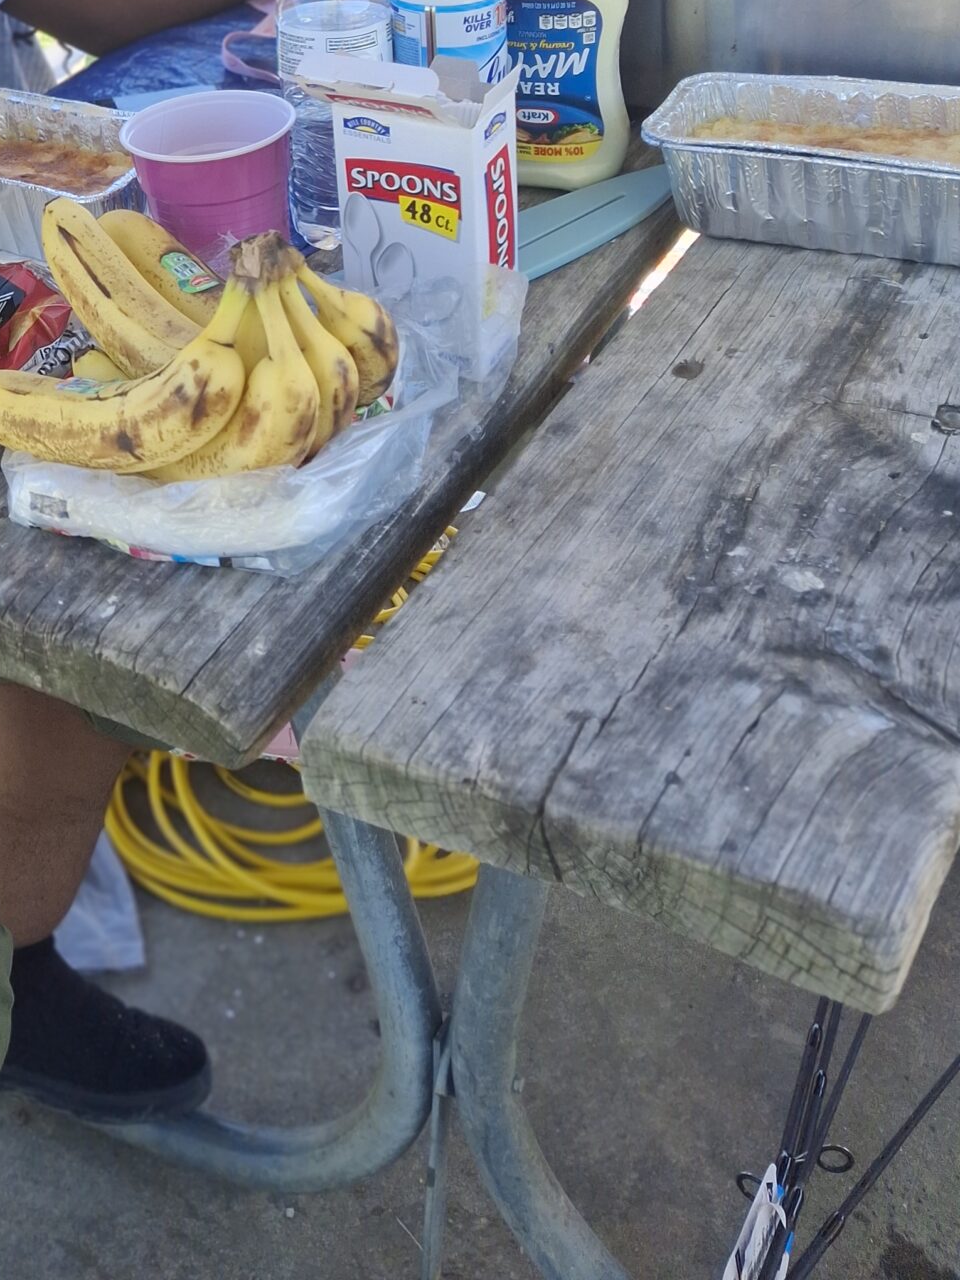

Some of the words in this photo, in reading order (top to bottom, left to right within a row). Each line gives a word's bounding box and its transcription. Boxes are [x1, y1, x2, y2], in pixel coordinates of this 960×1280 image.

[463, 11, 491, 25] KILLS
[465, 20, 491, 33] OVER
[539, 40, 575, 50] Creamy
[515, 82, 560, 96] REA
[522, 111, 549, 121] Kraft
[343, 128, 392, 145] ESSENTIALS
[534, 146, 562, 156] MORE
[564, 146, 584, 155] 10%
[350, 167, 458, 202] SPOONS
[405, 200, 432, 224] 48
[435, 215, 453, 232] Ct.
[491, 157, 510, 269] SPOON
